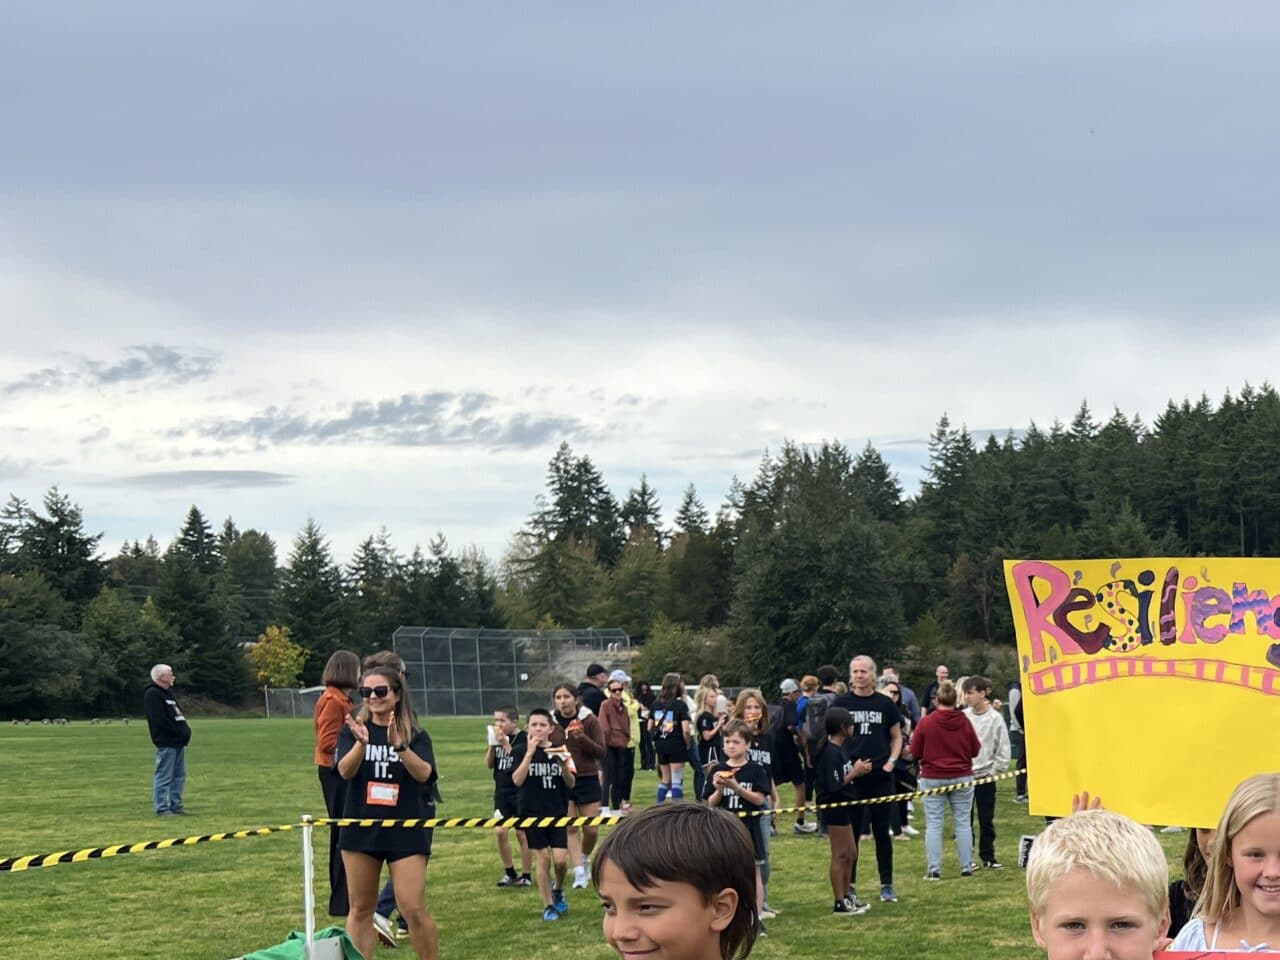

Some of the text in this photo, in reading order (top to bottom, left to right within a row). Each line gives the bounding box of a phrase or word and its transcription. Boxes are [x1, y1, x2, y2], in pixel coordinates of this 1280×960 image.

[365, 744, 402, 762] INIS
[374, 761, 393, 779] IT.
[543, 776, 556, 789] IT.
[729, 797, 743, 809] IT.
